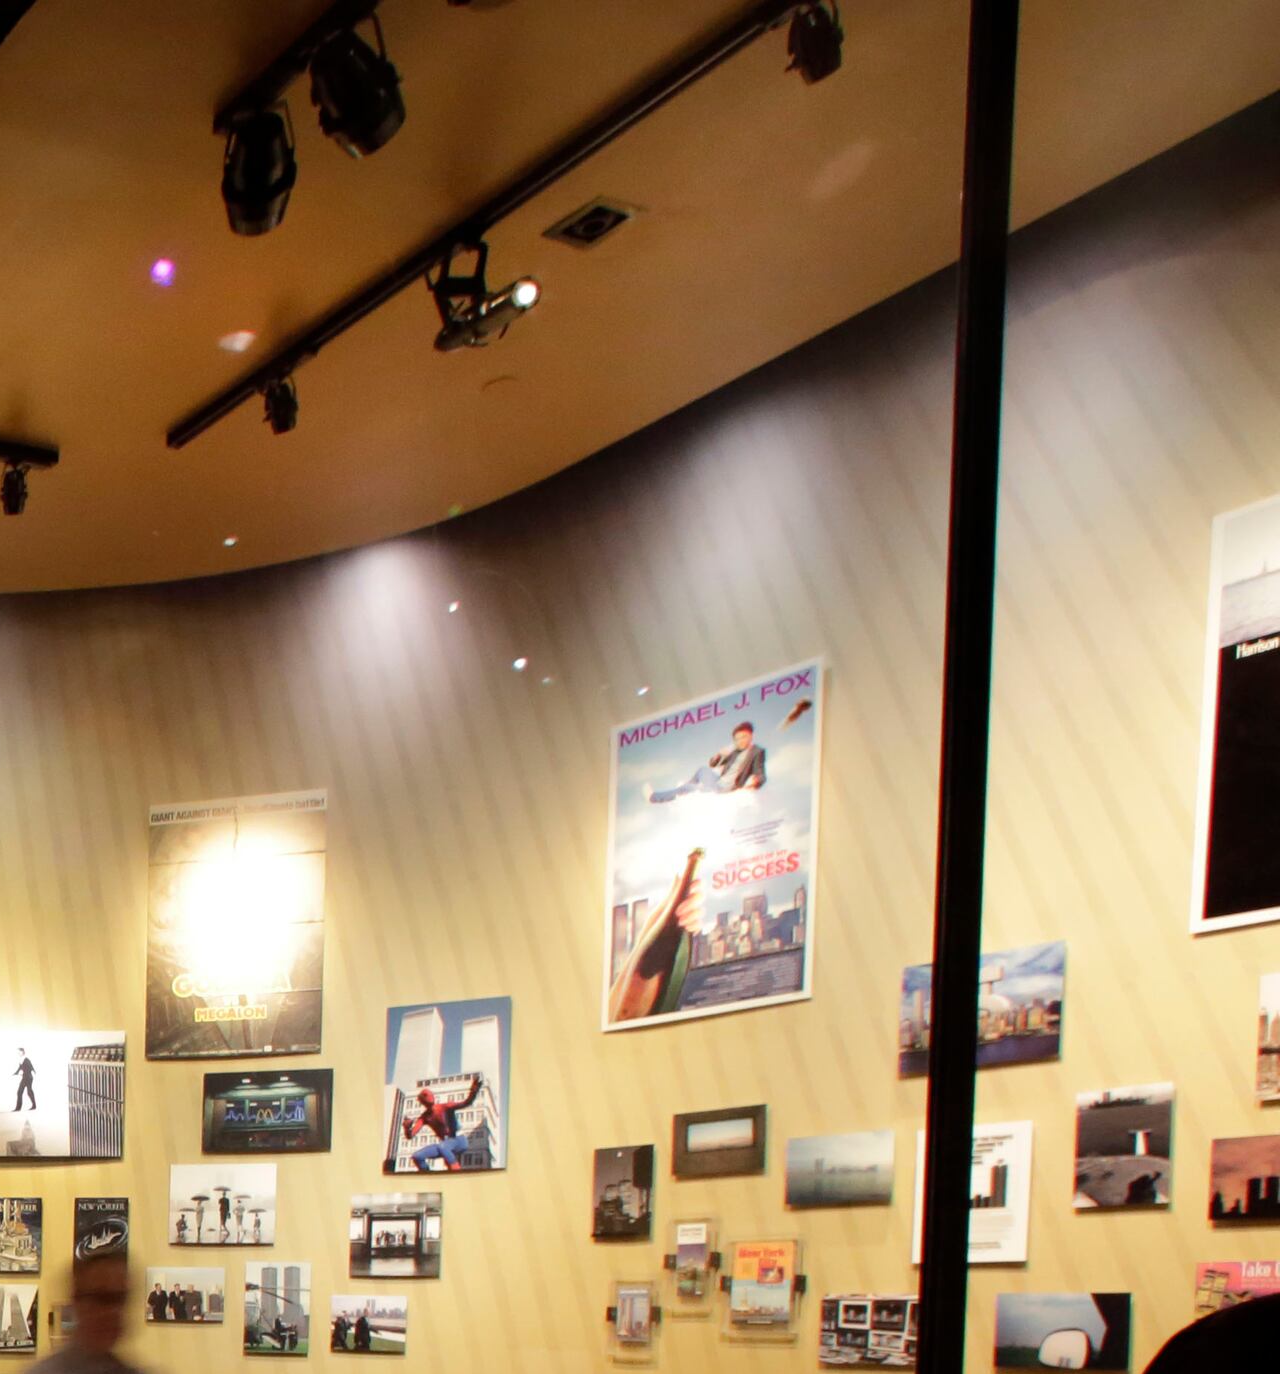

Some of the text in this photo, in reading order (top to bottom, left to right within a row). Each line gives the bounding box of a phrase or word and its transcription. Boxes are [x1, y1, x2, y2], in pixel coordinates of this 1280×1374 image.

[619, 670, 810, 747] MICHAEL J. FOX
[712, 851, 800, 890] SUCCESS
[195, 1005, 267, 1022] MEGALON
[1242, 1261, 1272, 1278] Take
